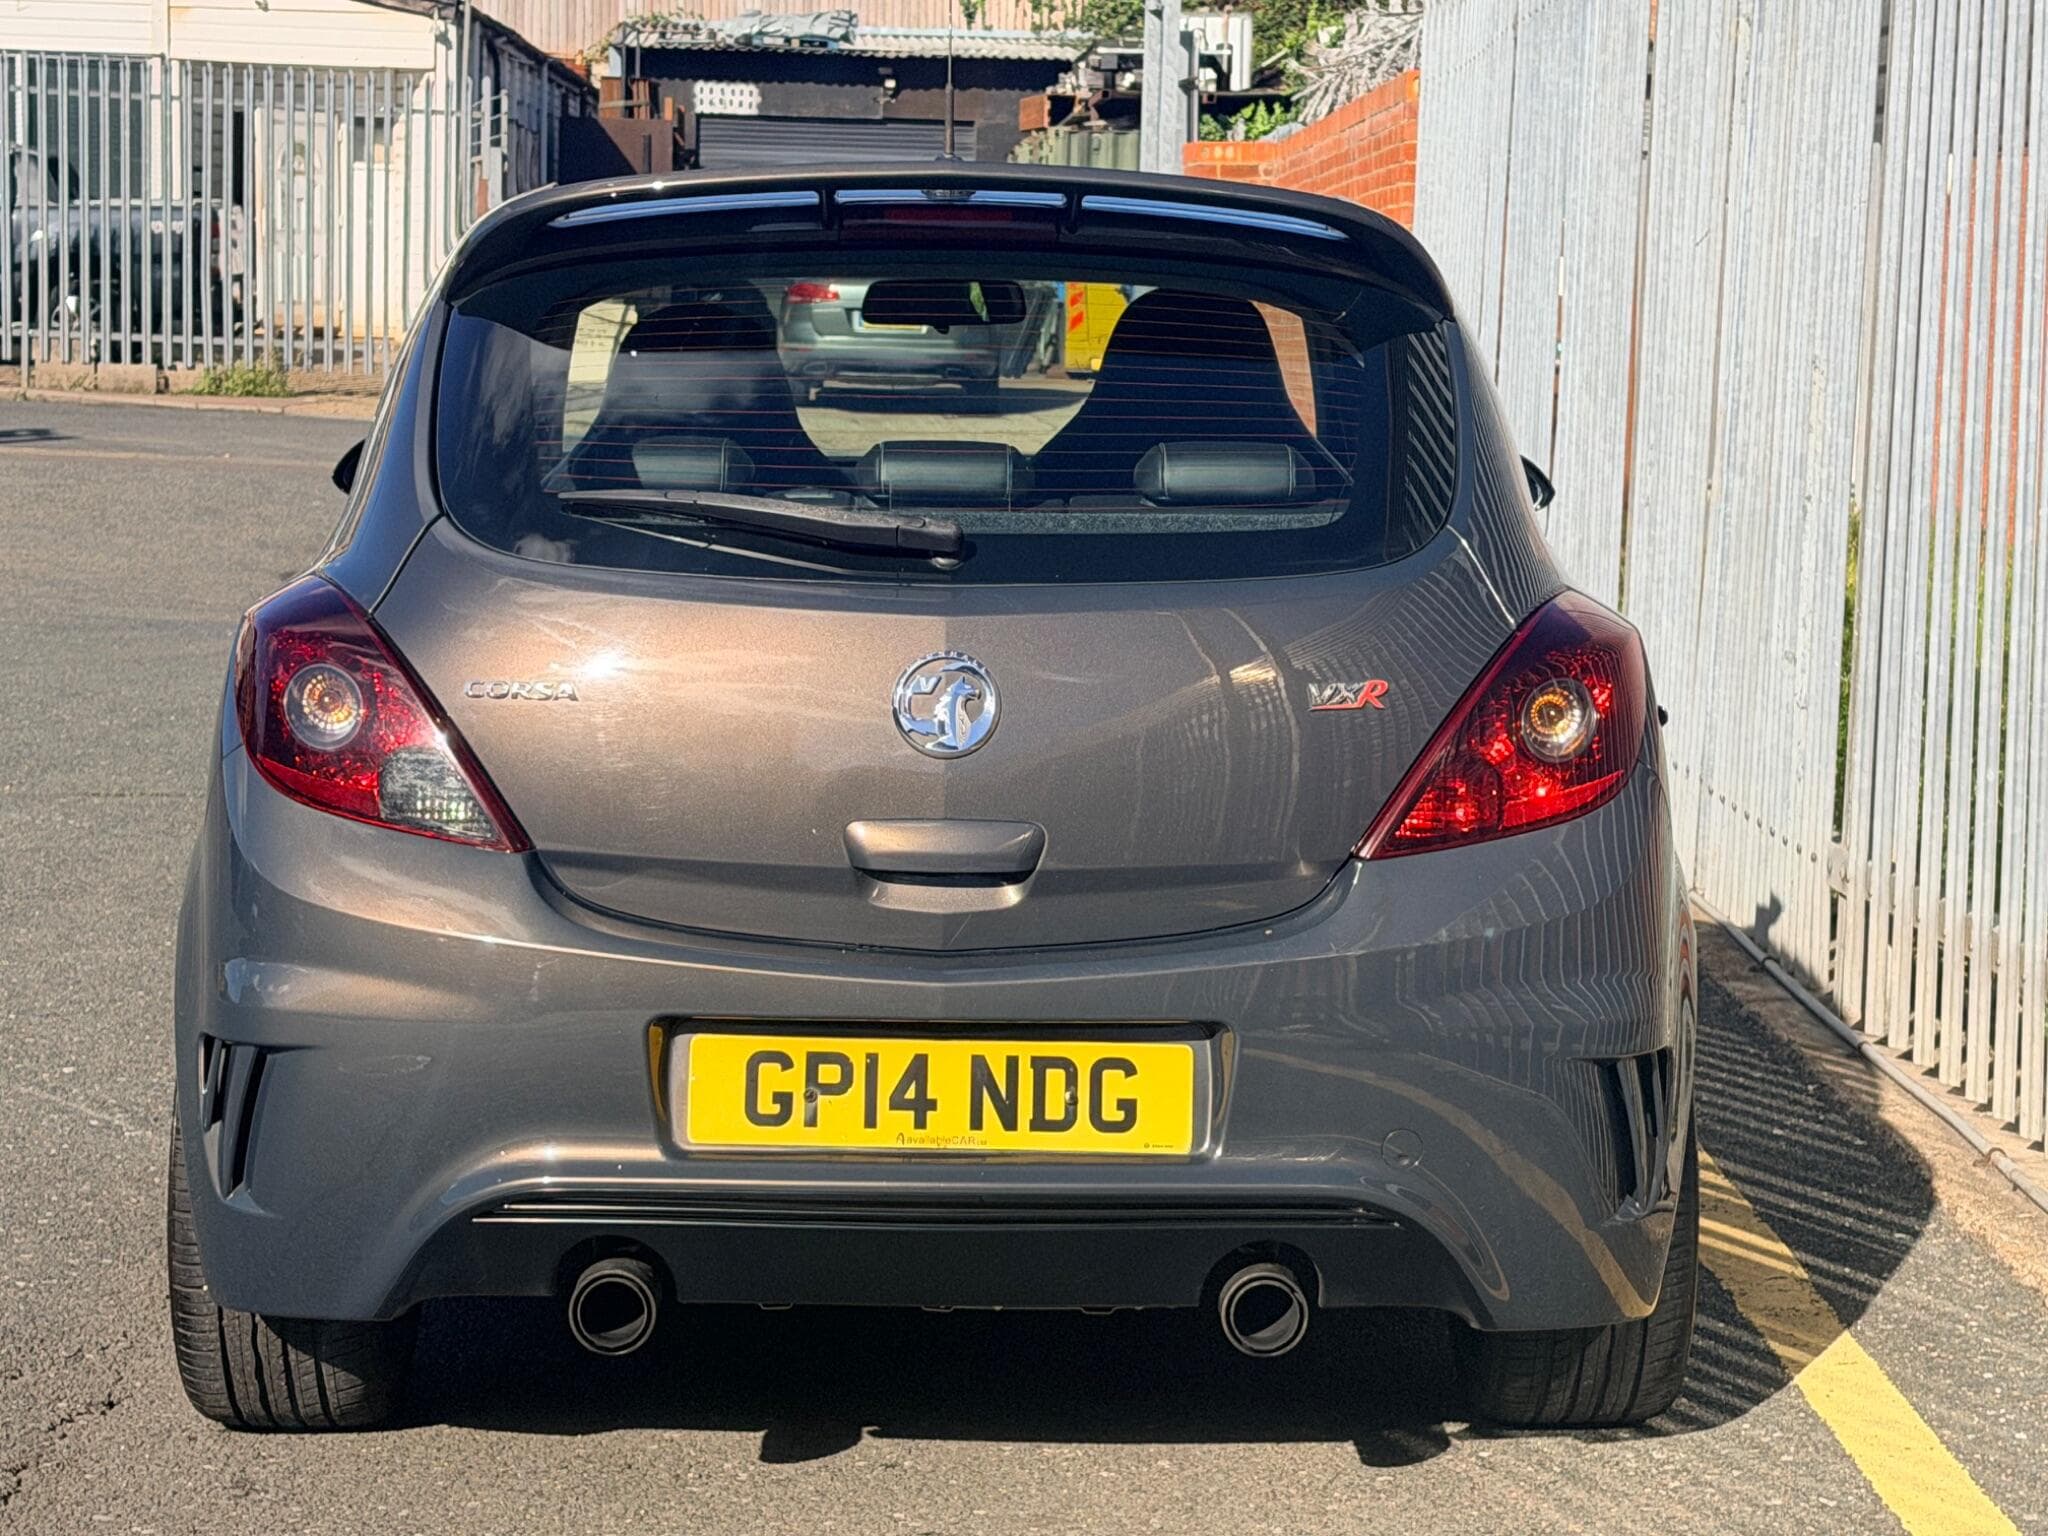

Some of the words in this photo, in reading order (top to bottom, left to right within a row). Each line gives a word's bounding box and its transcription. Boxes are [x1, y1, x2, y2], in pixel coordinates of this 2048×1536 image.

[464, 680, 579, 701] CORSA
[1307, 680, 1389, 711] VXR
[744, 1050, 938, 1129] GP14
[970, 1054, 1138, 1133] NDG
